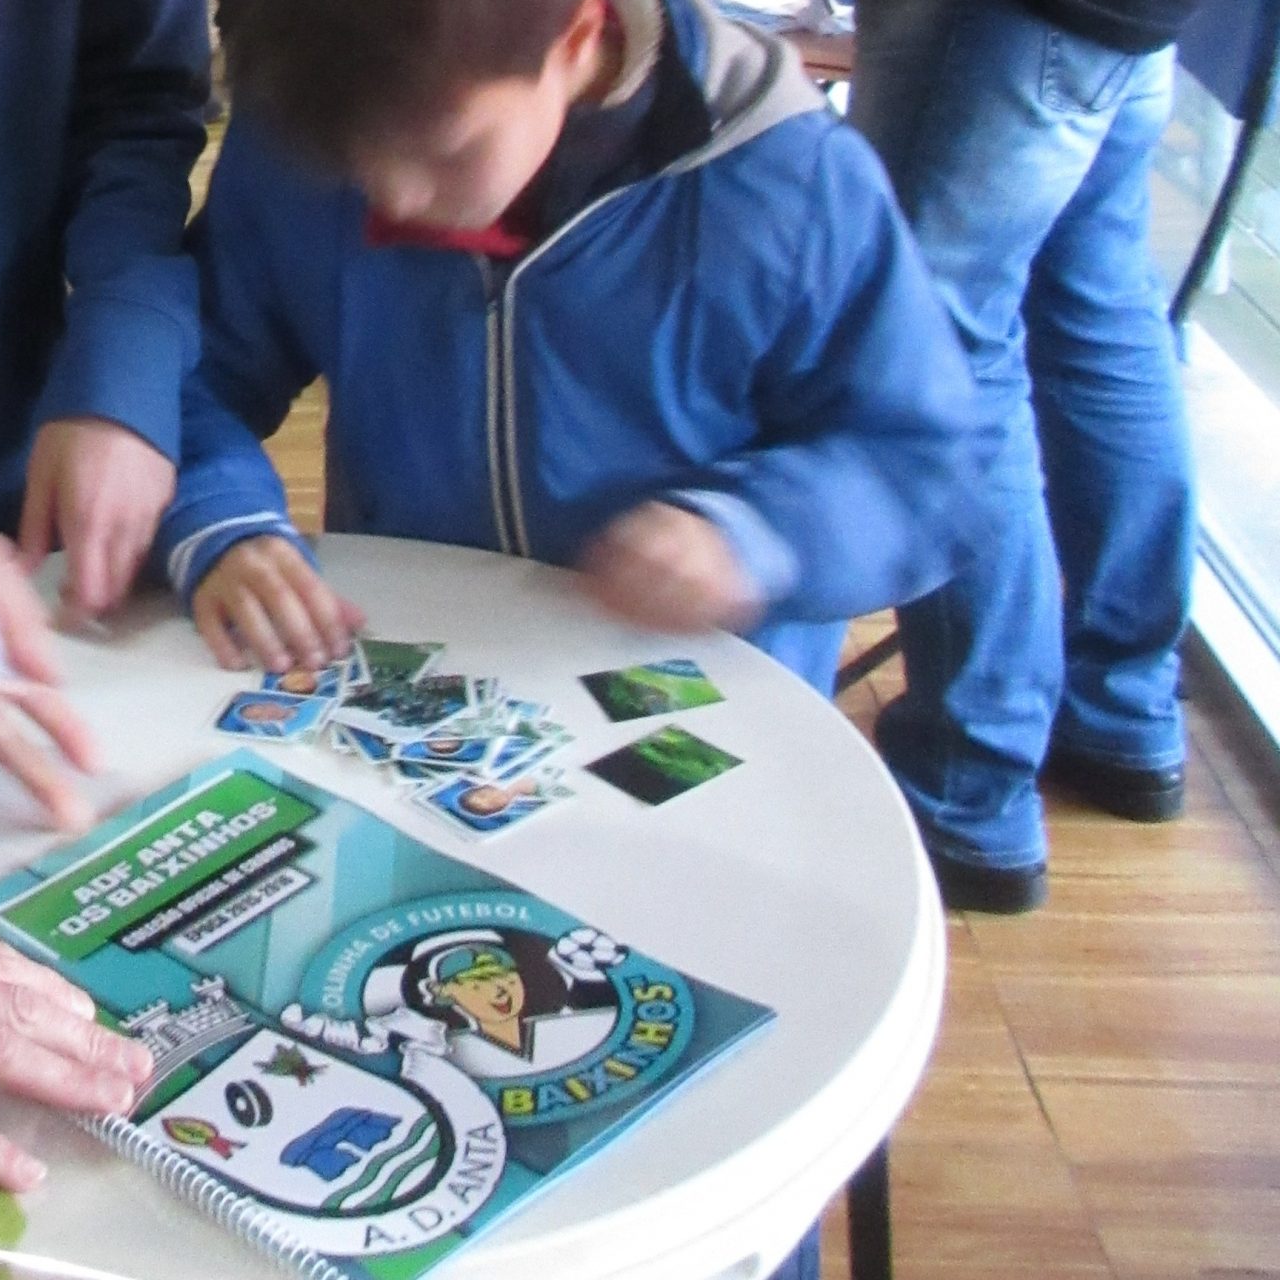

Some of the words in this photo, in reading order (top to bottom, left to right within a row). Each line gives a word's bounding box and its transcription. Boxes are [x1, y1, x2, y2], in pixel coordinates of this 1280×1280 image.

[74, 860, 132, 904] ADF
[136, 809, 224, 867] ANTA
[322, 940, 373, 1016] OLINHA
[370, 919, 404, 941] DE
[406, 902, 532, 927] FUTEBOL
[501, 977, 674, 1115] BAIXINHOS
[447, 1122, 498, 1205] ANTA
